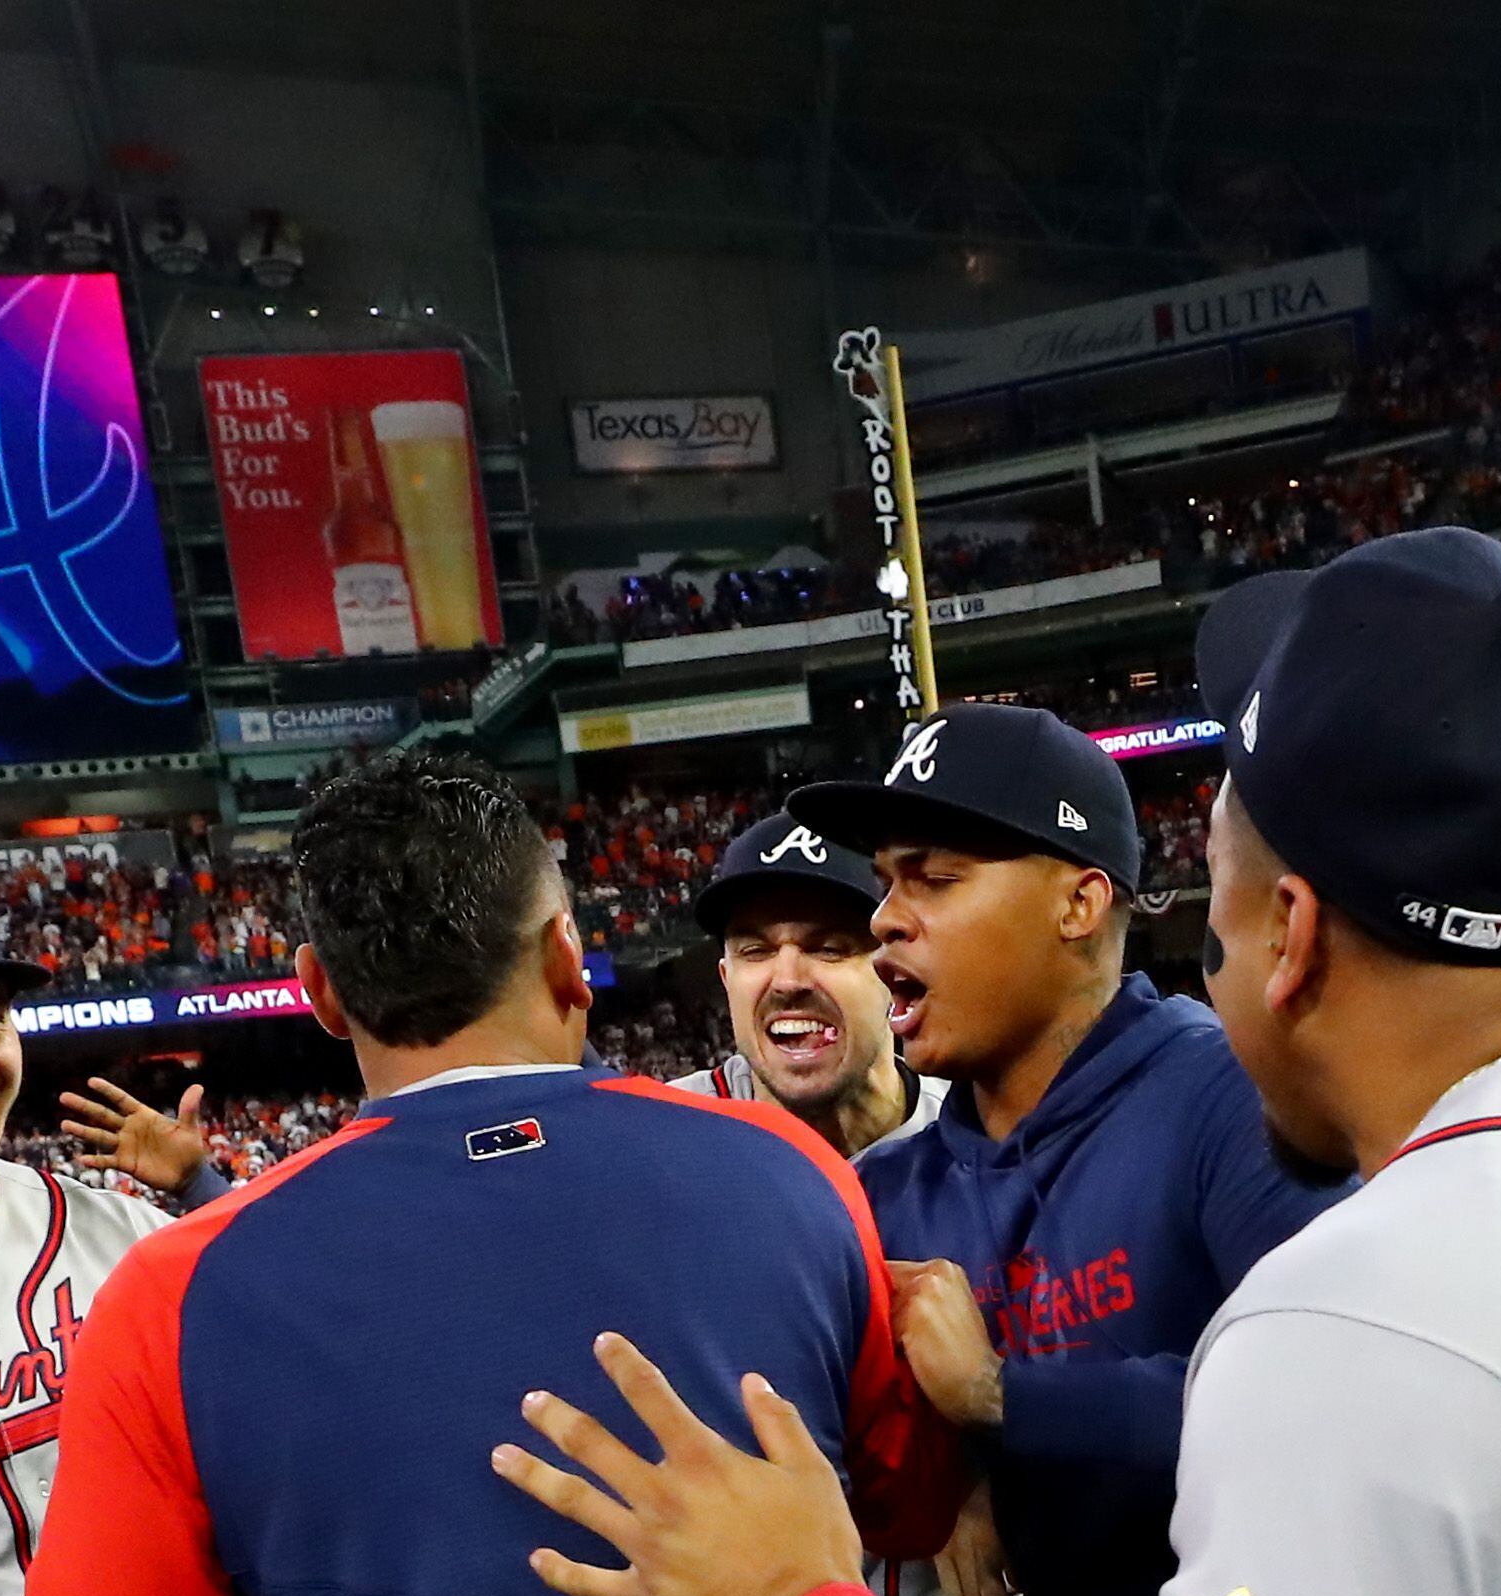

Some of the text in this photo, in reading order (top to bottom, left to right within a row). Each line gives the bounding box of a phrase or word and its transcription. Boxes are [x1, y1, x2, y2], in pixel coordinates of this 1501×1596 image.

[1183, 276, 1329, 336] ULTRA
[206, 378, 290, 411] This
[216, 411, 312, 445] Bud's
[221, 447, 281, 477] For
[225, 480, 303, 511] You.
[861, 418, 900, 548] ROOT
[272, 704, 394, 729] CHAMPION
[1401, 900, 1438, 930] 44
[177, 987, 295, 1017] ATLANTA
